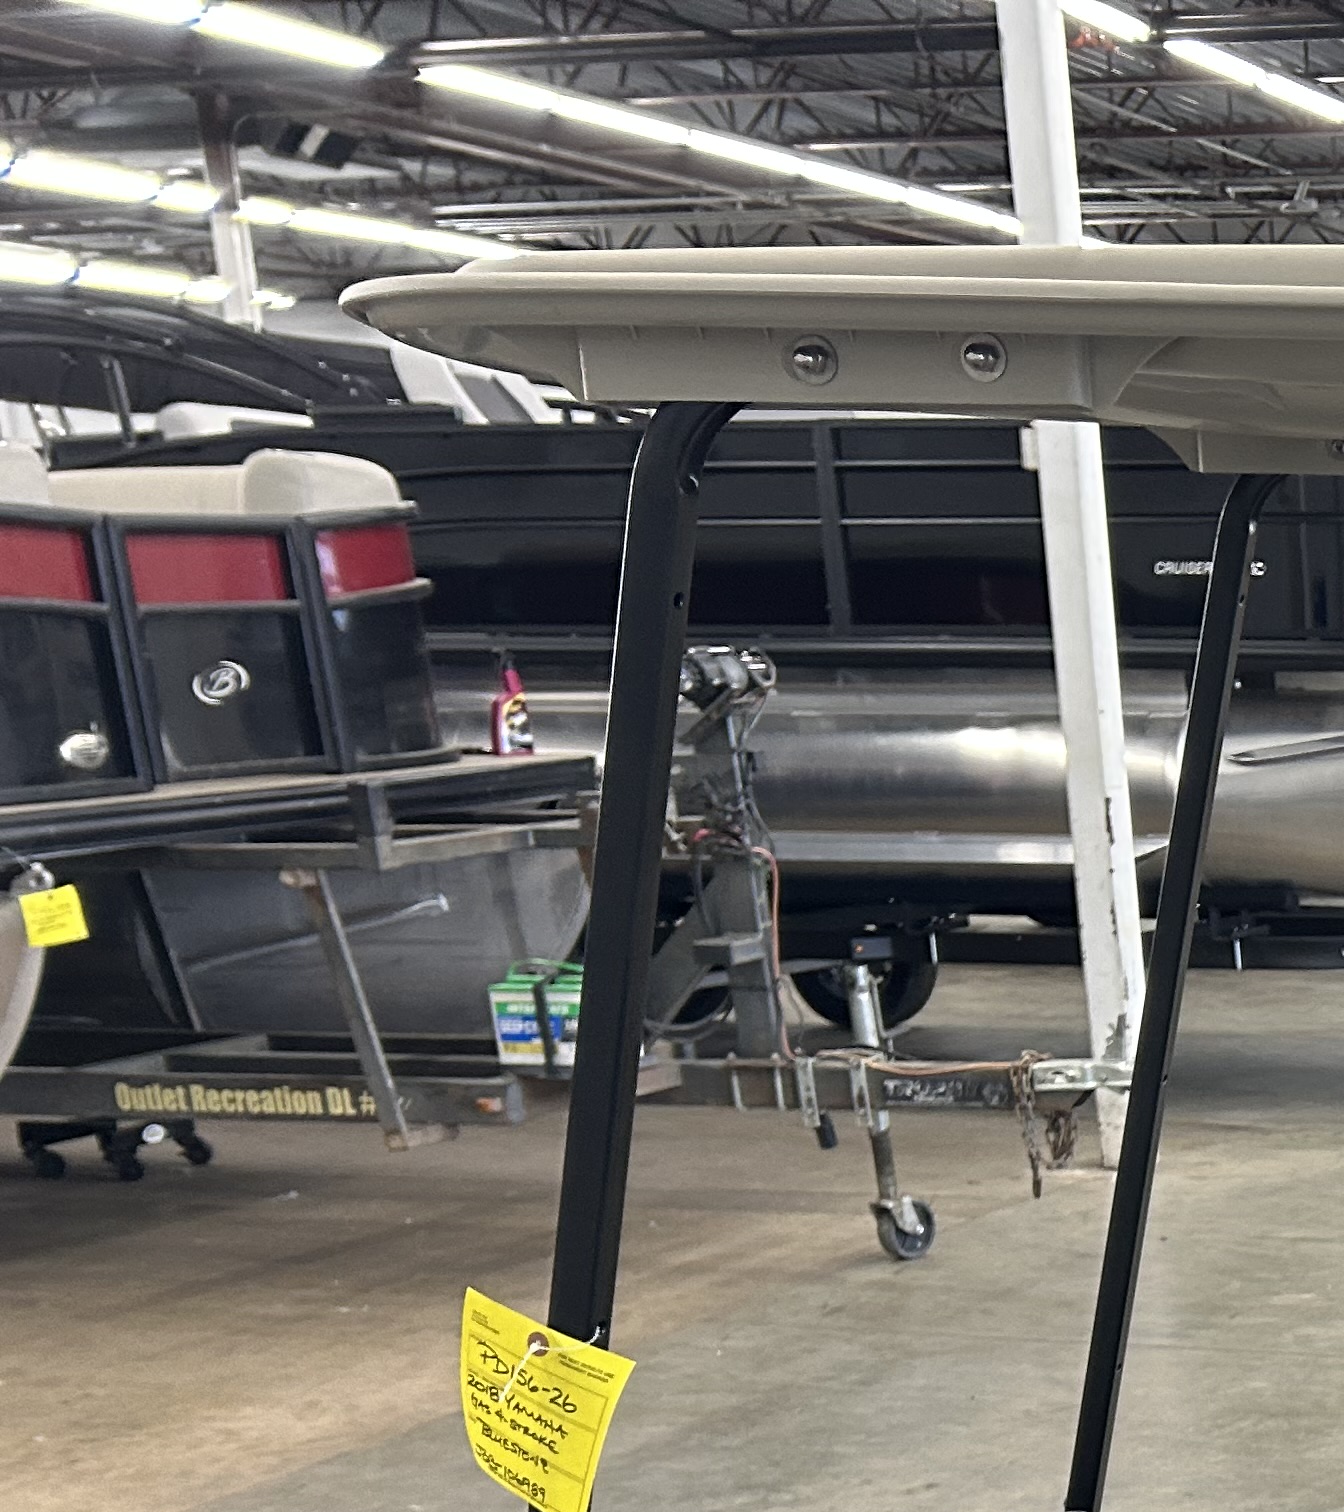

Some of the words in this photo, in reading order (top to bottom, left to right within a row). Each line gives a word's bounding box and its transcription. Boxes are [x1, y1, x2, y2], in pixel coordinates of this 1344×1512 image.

[114, 1082, 189, 1113] Outlet
[189, 1083, 325, 1116] Recreation
[504, 1393, 569, 1440] YAMAHA
